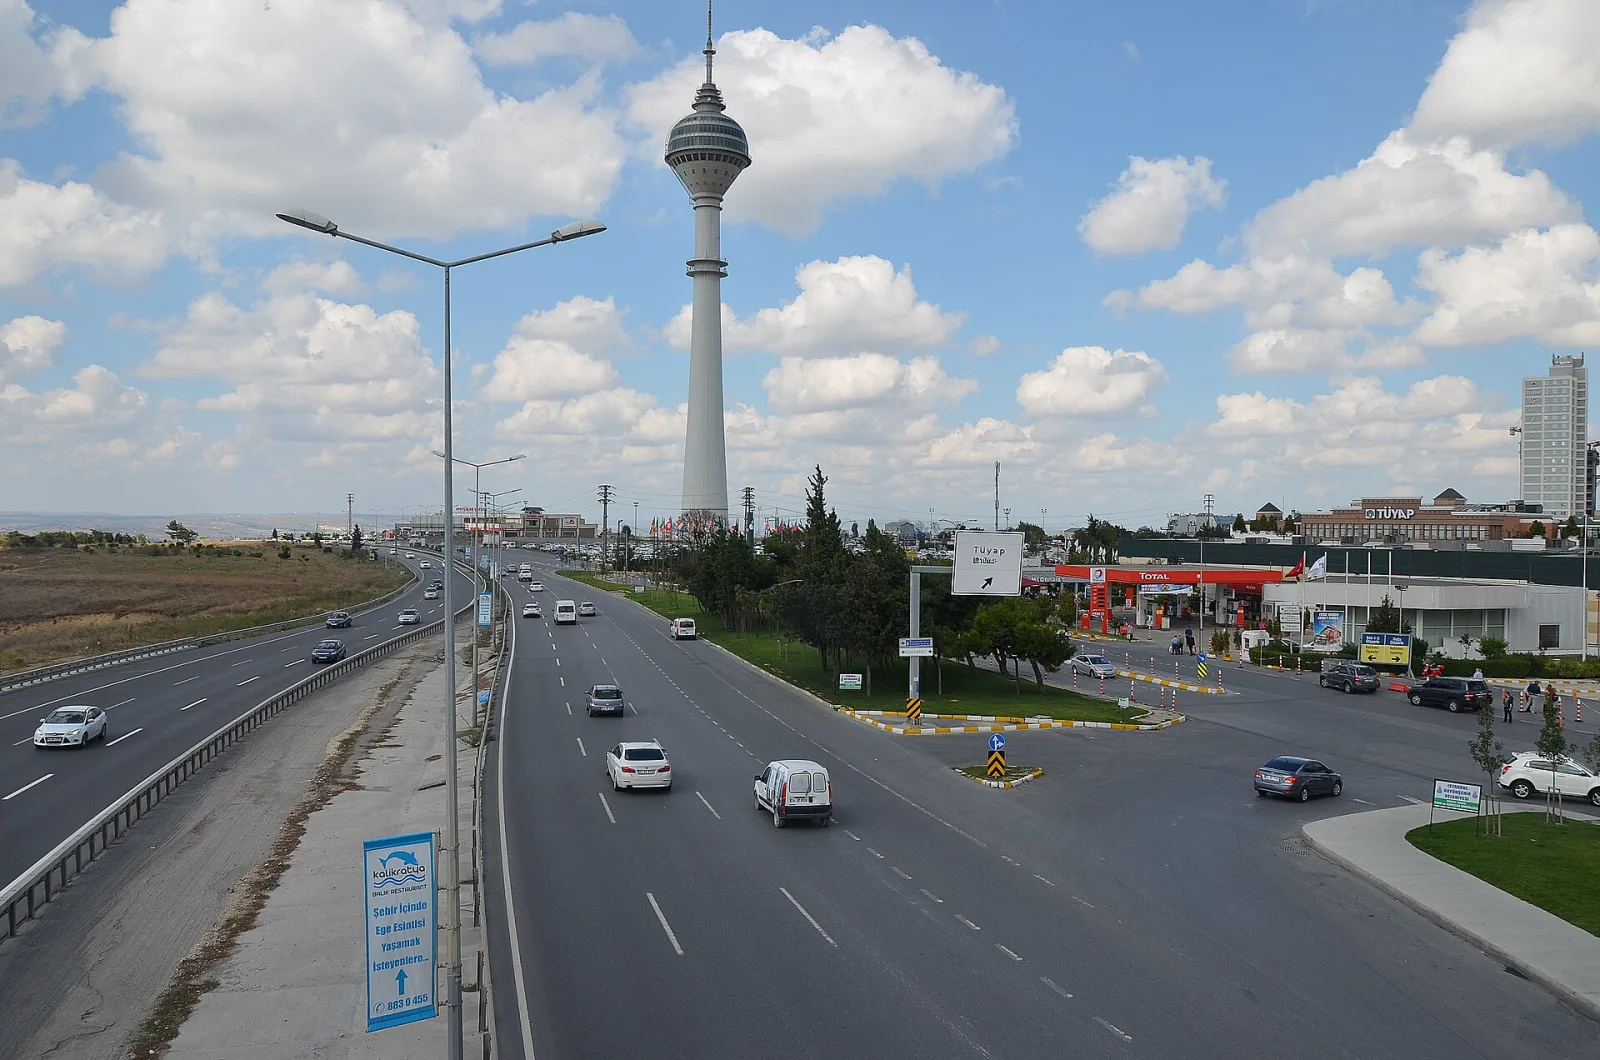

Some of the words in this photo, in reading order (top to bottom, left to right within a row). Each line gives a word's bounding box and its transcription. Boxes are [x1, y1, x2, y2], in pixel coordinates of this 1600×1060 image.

[1376, 506, 1415, 519] TÜYAP
[973, 546, 1006, 556] Tüyap
[373, 865, 426, 879] kalikratya
[391, 884, 427, 894] RESTAURANT
[373, 905, 398, 919] Şehir
[400, 901, 428, 914] İçinde
[375, 924, 392, 936] Ege
[394, 918, 426, 932] Esintisi
[381, 936, 421, 952] Yaşamak
[387, 999, 404, 1011] 883
[405, 997, 411, 1007] 0
[412, 993, 428, 1005] 455
